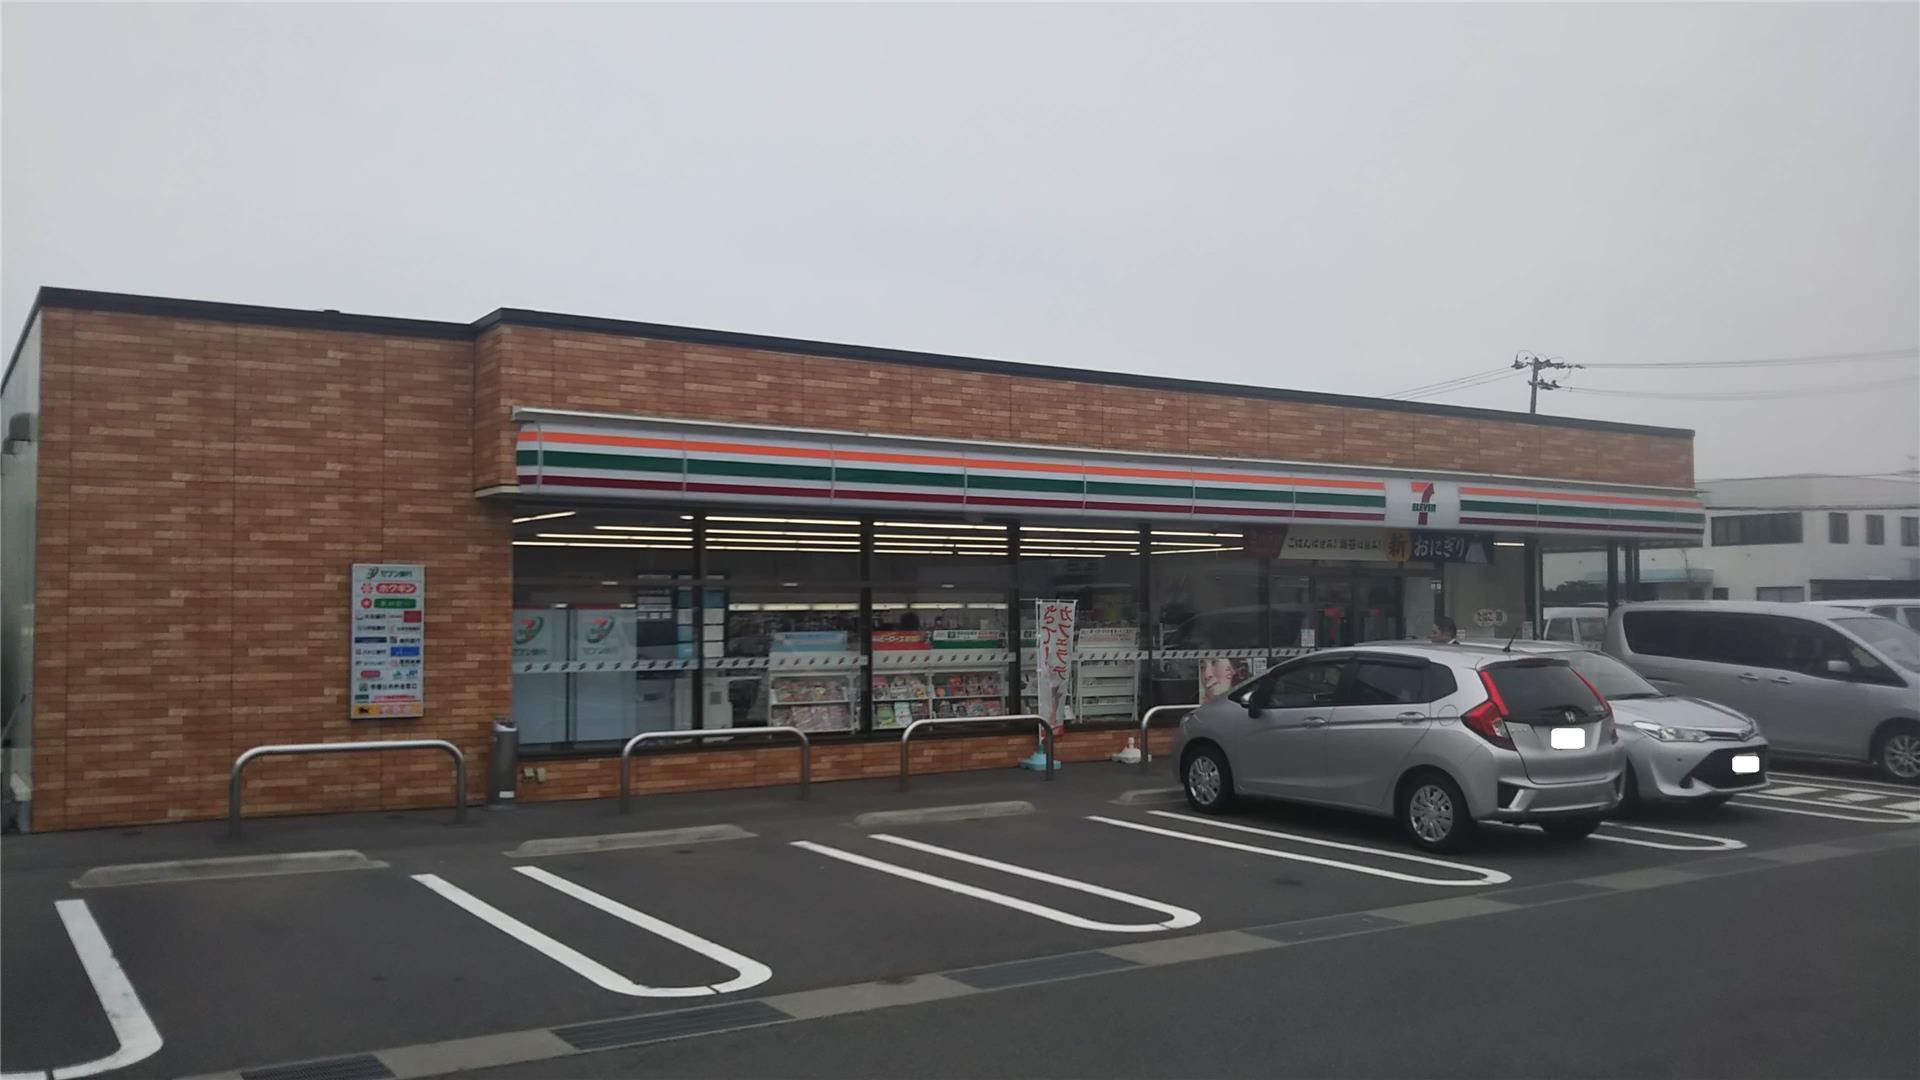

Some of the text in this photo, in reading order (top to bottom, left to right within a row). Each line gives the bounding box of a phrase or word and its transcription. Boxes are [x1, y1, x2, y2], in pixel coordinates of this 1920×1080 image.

[1411, 482, 1436, 524] 7
[1414, 535, 1465, 558] おにぎり
